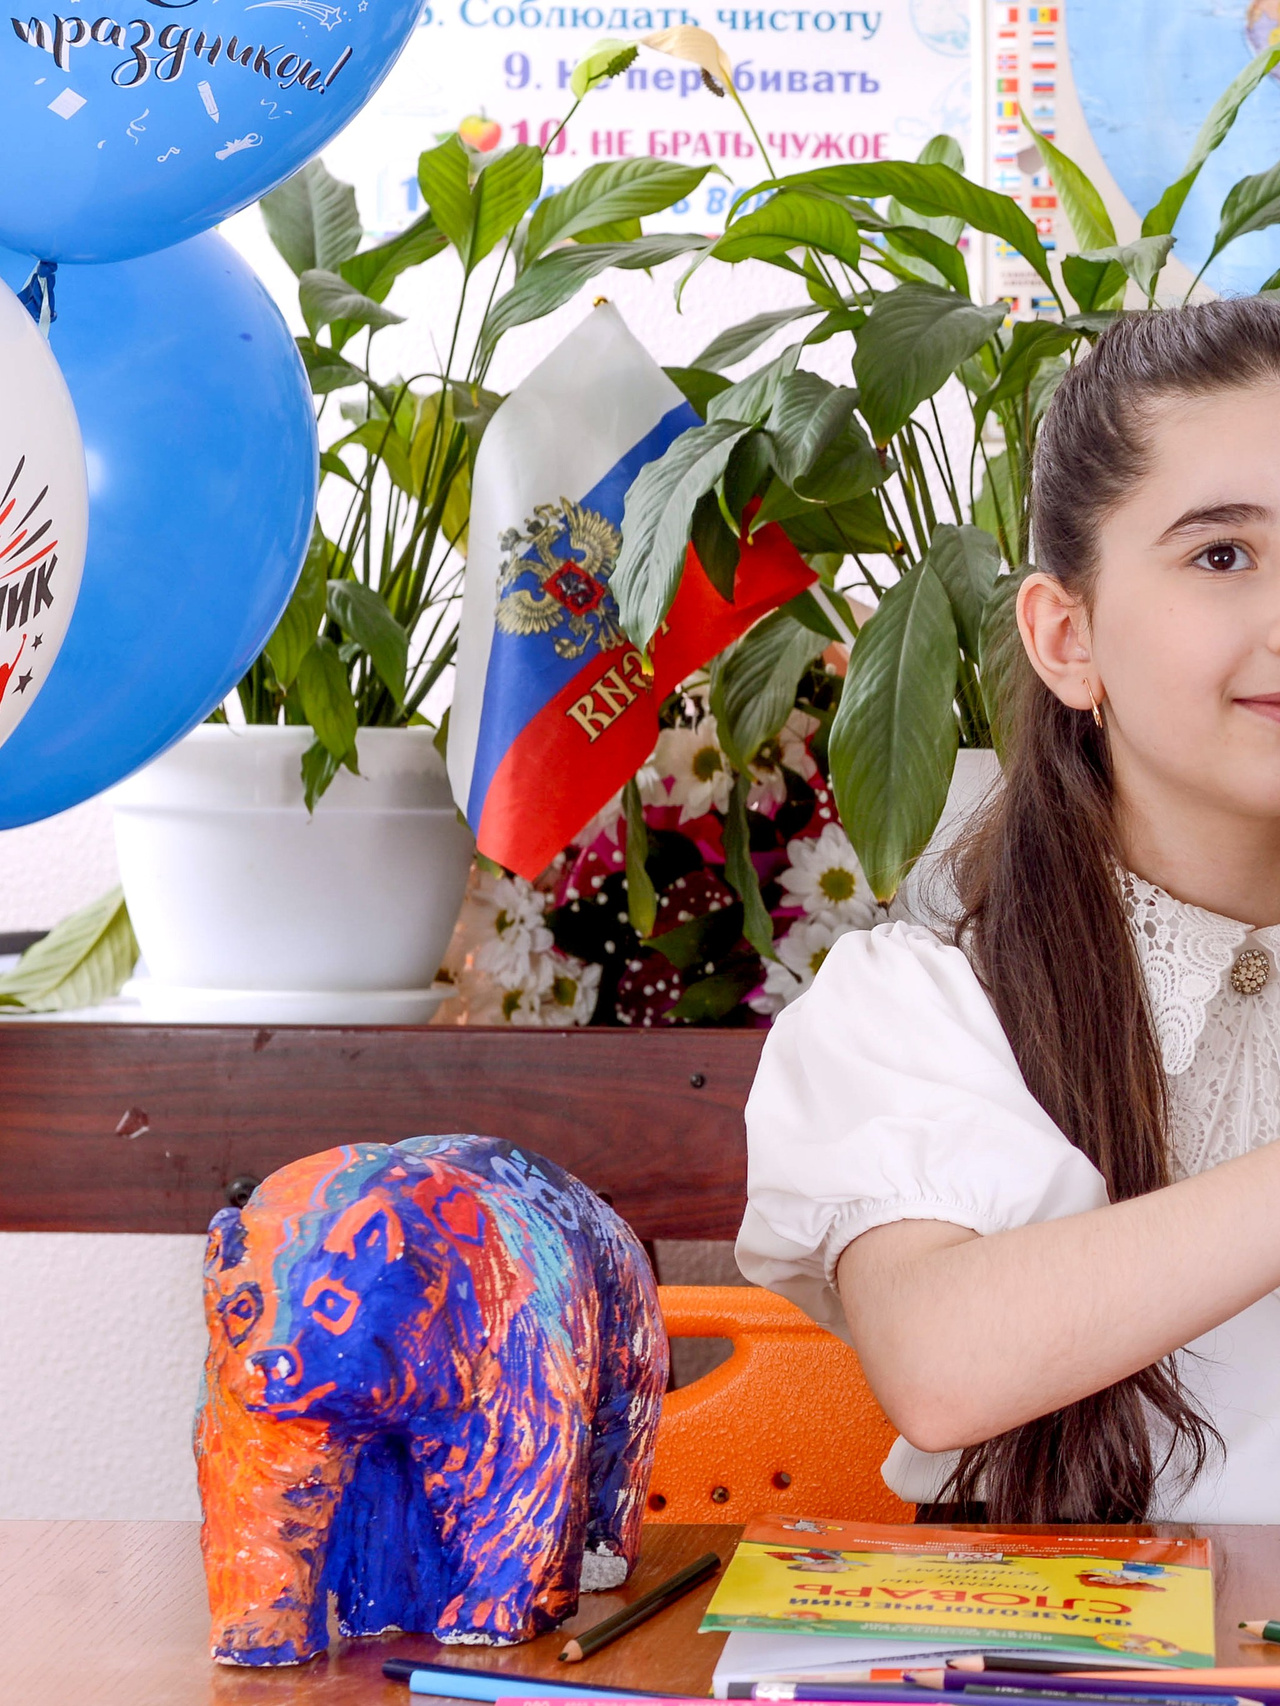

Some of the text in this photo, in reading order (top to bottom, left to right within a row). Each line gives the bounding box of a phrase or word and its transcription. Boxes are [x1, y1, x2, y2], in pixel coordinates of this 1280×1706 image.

[716, 8, 882, 40] чистоту
[10, 13, 354, 95] праздником!
[505, 52, 544, 90] 9.
[627, 60, 880, 98] пербивать
[512, 119, 891, 160] 10. НЕ БРАТЬ ЧУЖОЕ
[789, 1598, 1133, 1626] ФРАЗЕОЛОГИЧЕСКИЙ
[793, 1583, 1133, 1615] СЛОВАРЬ
